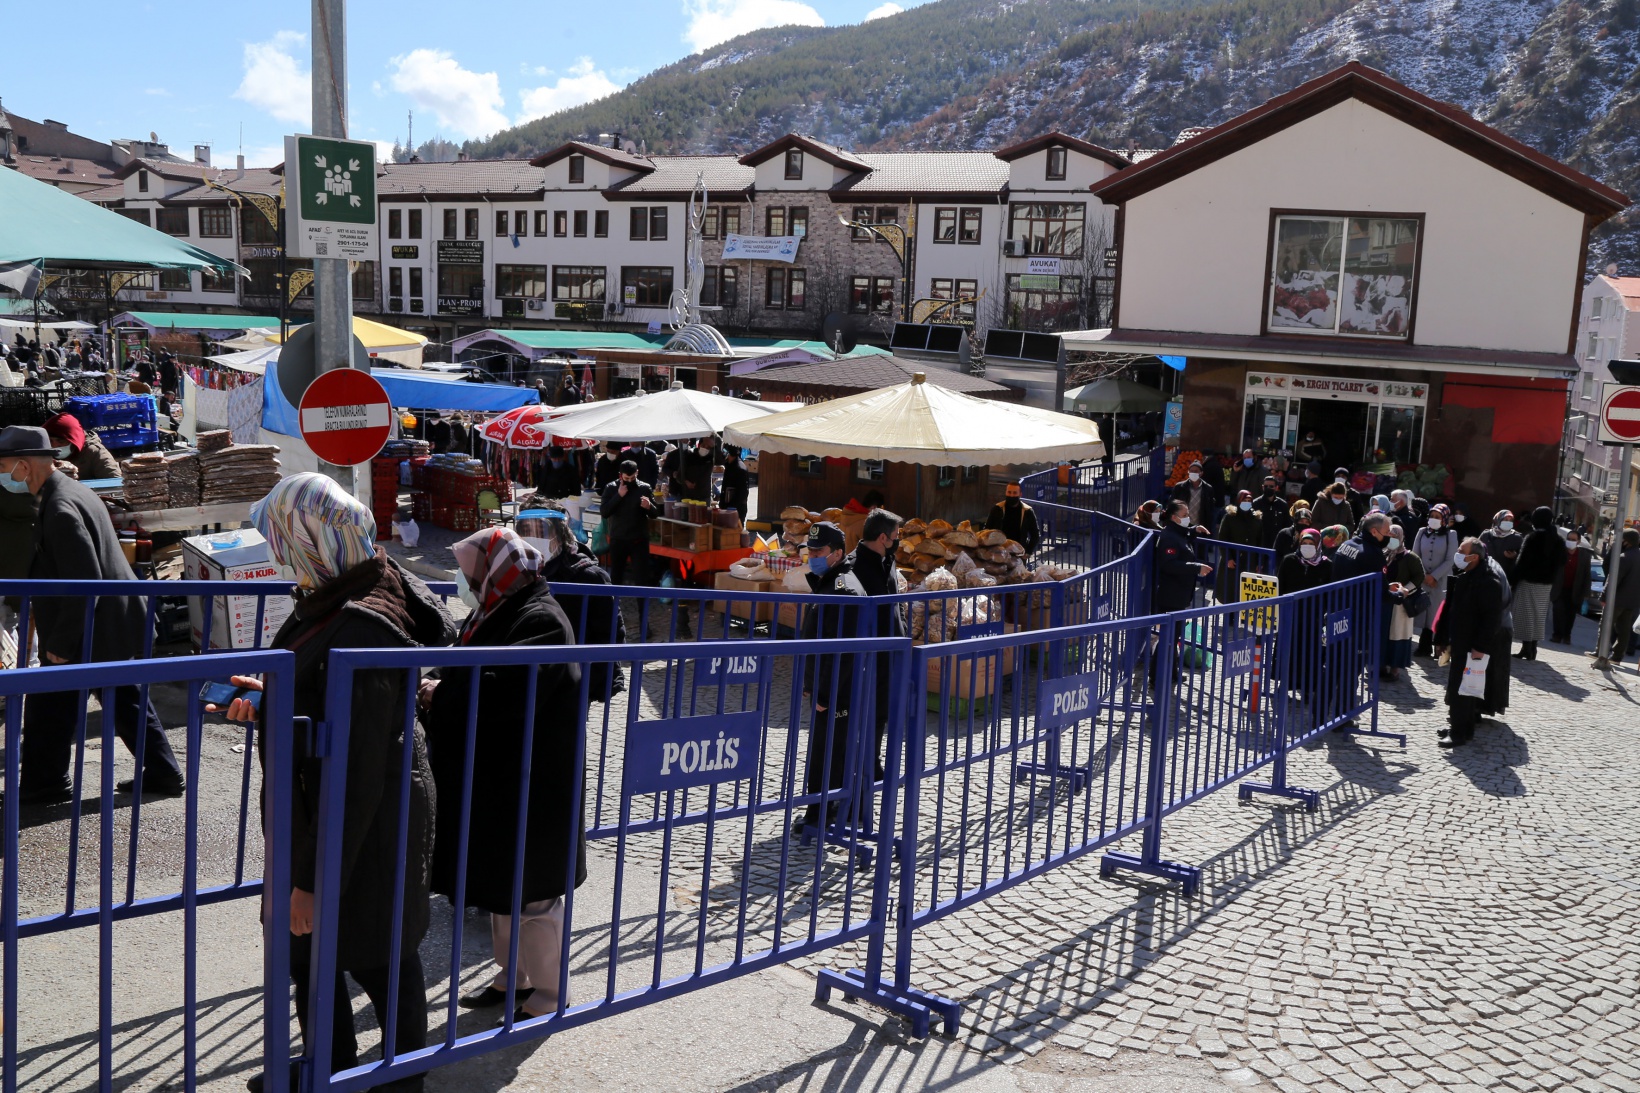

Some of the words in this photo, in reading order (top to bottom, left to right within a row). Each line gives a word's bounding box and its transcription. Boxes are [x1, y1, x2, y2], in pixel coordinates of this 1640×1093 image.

[244, 571, 254, 580] 14
[1244, 583, 1275, 595] MURAT
[1098, 601, 1109, 619] POLİS
[1334, 616, 1348, 635] POLİS
[1232, 646, 1250, 668] POLİS
[1053, 684, 1089, 716] POLİS
[660, 731, 740, 775] POLİS
